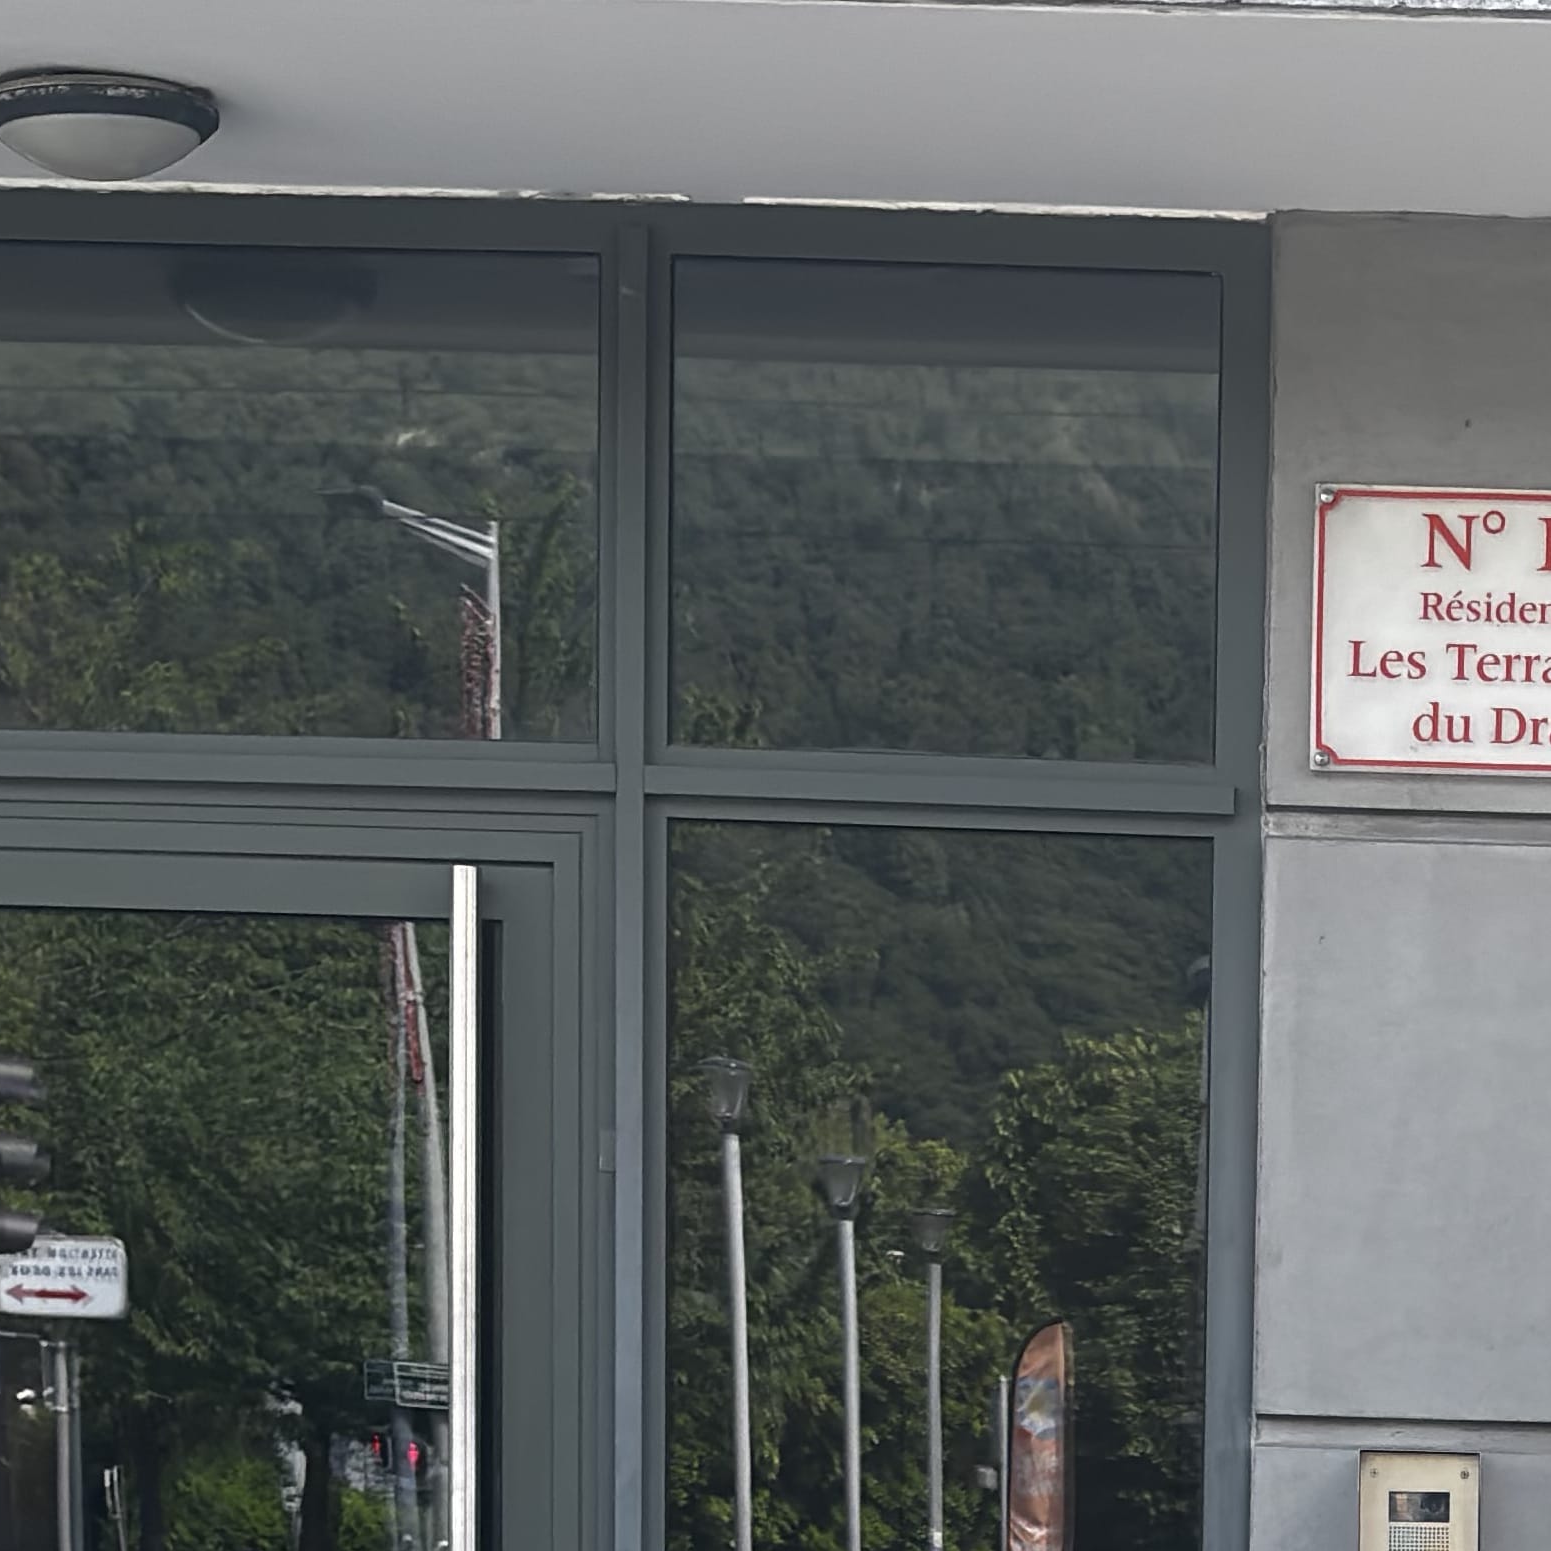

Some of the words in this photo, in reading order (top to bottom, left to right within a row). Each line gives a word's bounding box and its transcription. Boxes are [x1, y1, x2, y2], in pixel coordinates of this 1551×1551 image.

[1420, 510, 1506, 571] N°
[1347, 640, 1427, 680] Les
[1412, 702, 1473, 743] du
